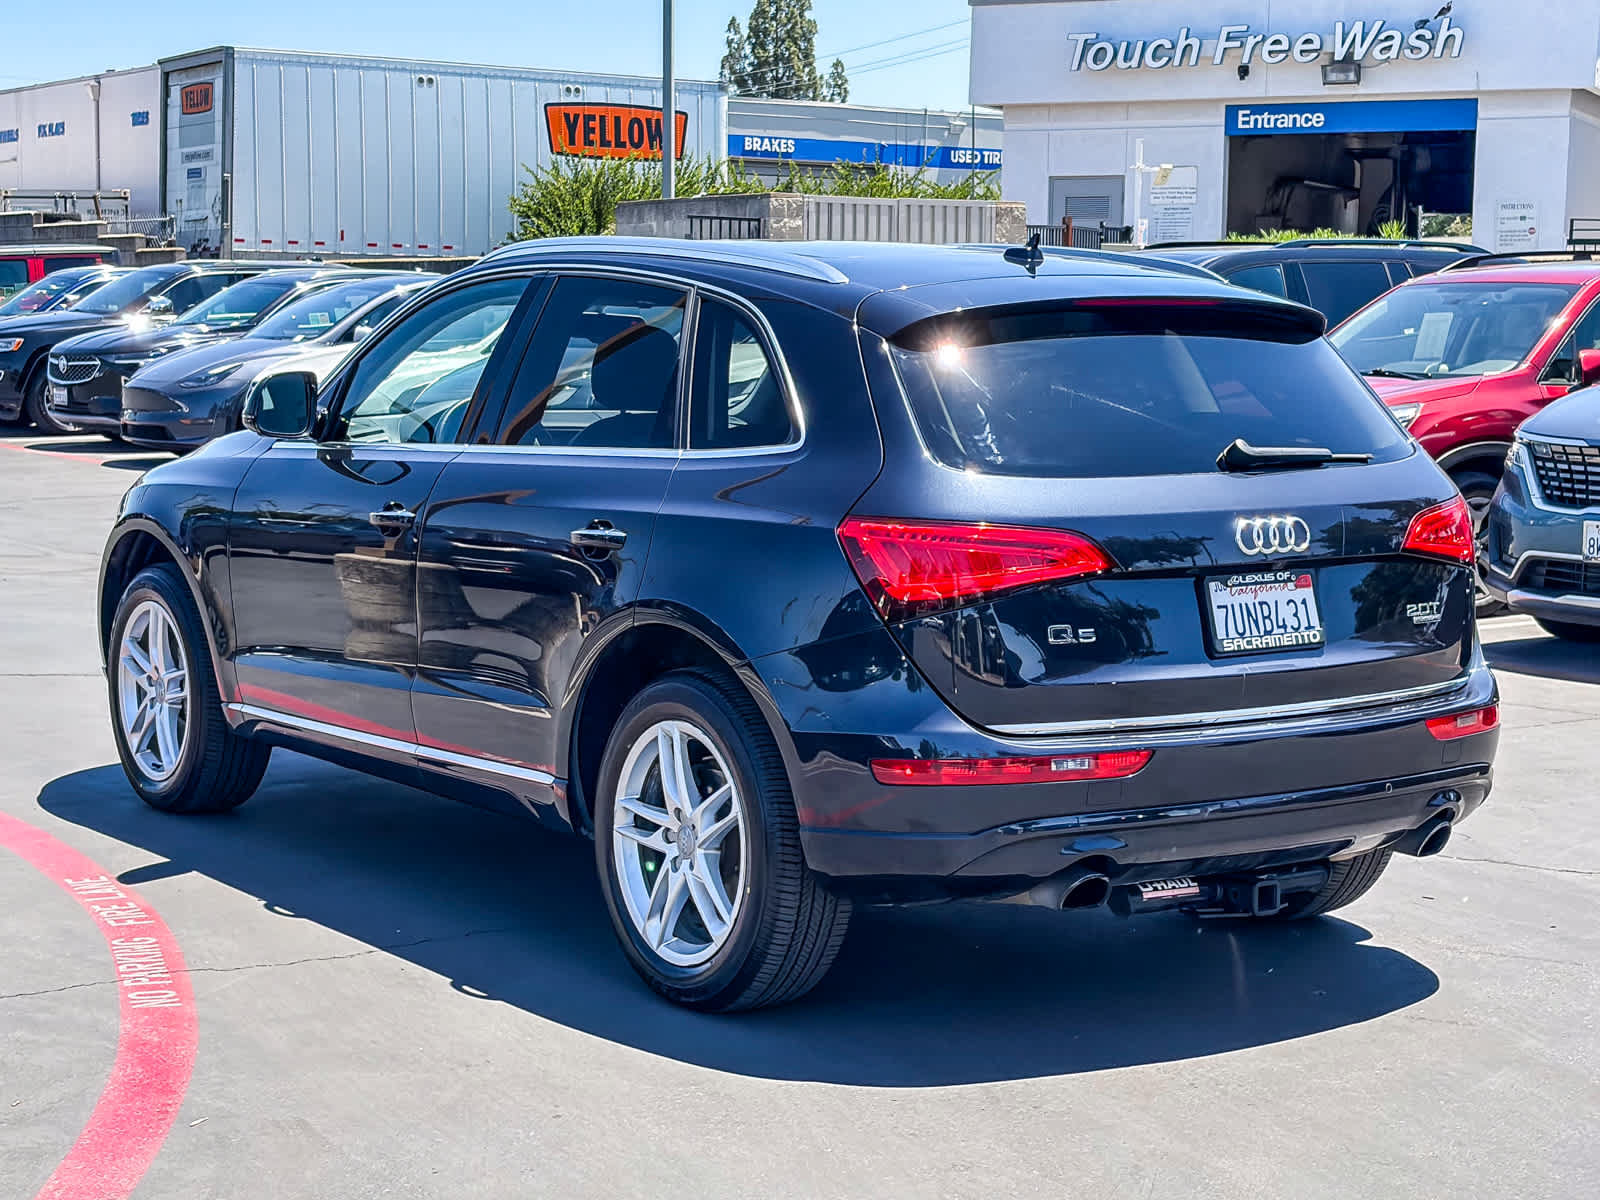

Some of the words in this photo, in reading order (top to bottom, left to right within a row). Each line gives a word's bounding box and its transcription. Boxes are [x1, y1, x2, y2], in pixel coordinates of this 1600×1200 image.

[1067, 26, 1201, 72] Touch
[1212, 24, 1322, 65] Free
[1332, 17, 1465, 61] Wash
[185, 87, 210, 111] YELLOW
[1237, 109, 1325, 129] Entrance
[563, 112, 663, 151] YELLOW
[744, 136, 795, 153] BRAKES
[950, 150, 981, 164] USED
[1240, 573, 1275, 584] LEXUS
[1276, 571, 1291, 581] OF
[1216, 597, 1316, 638] 7UNB431
[1047, 624, 1097, 645] Q5
[1223, 630, 1321, 652] SACRAMENTO
[64, 875, 127, 902] LANE
[91, 901, 155, 927] FIRE
[111, 936, 173, 987] PARKING
[127, 989, 183, 1009] NO
